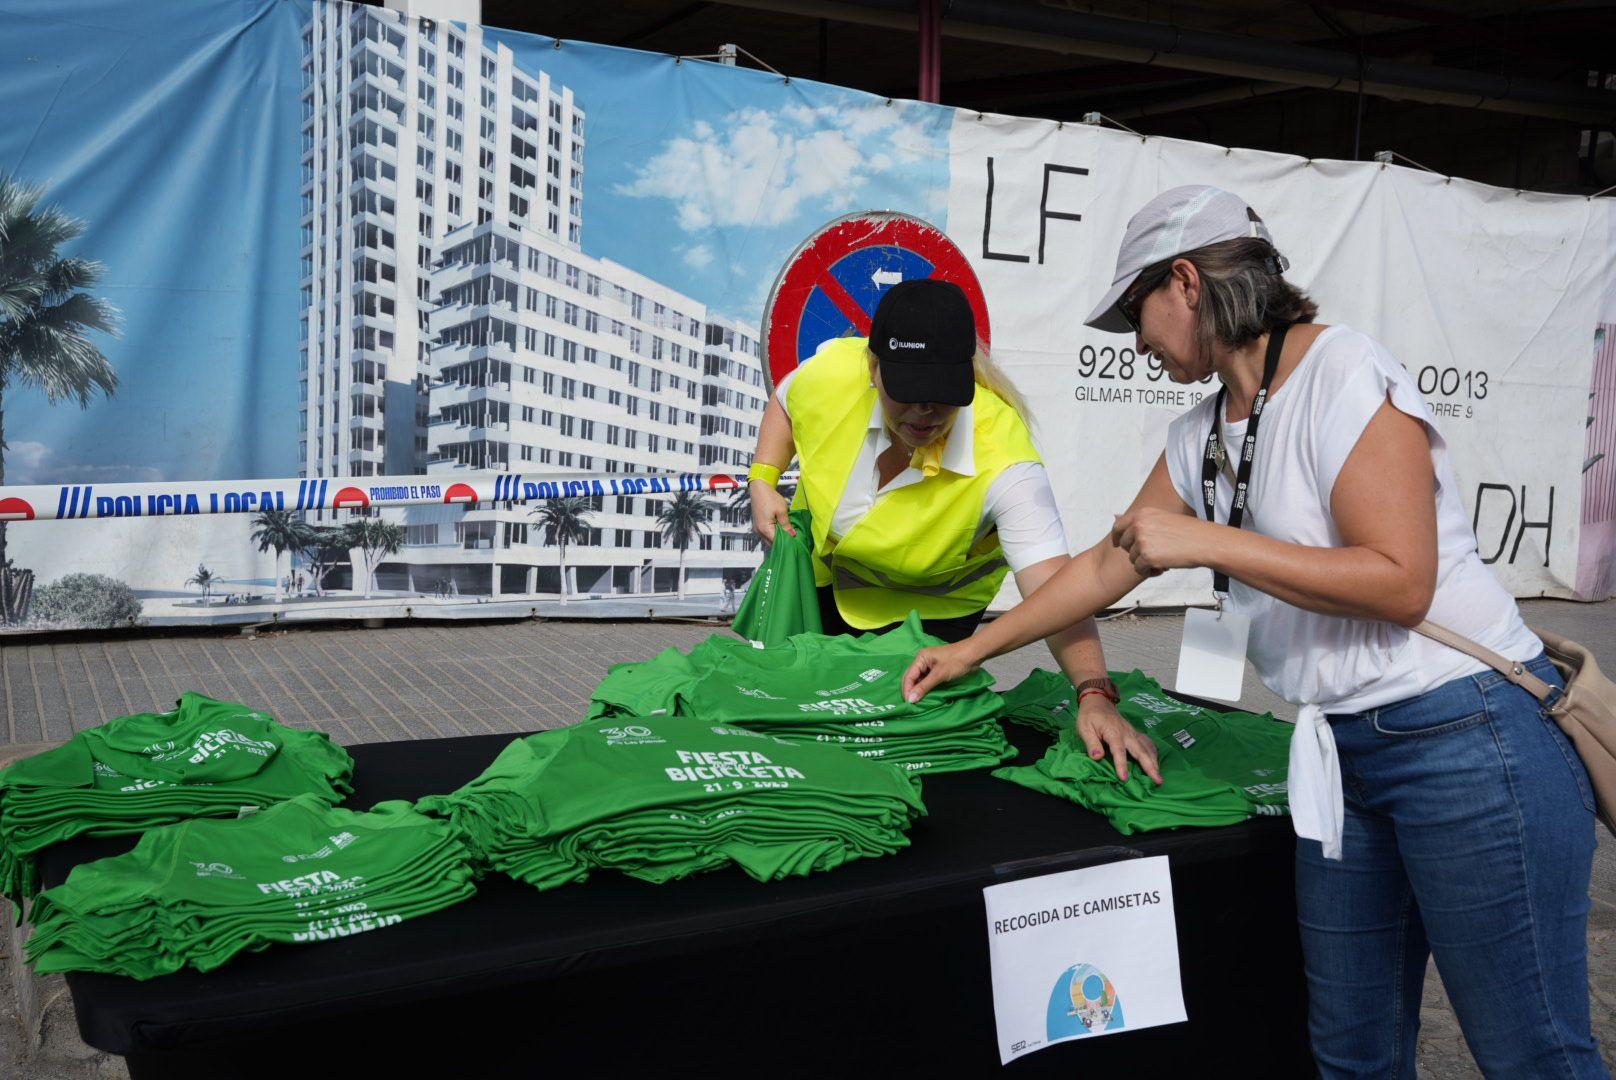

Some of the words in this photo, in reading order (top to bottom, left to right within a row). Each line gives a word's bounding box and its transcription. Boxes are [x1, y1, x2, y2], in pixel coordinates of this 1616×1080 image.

[899, 342, 926, 350] ILUNION
[1078, 345, 1136, 380] 928
[1417, 366, 1489, 400] 0013
[1075, 386, 1132, 404] GILMAR
[1136, 389, 1185, 405] TORRE
[370, 486, 409, 500] PROHIBIDO
[410, 485, 419, 499] EL
[420, 485, 441, 499] PASO
[523, 480, 600, 499] POLICIA
[609, 477, 671, 496] LOCAL
[97, 493, 200, 518] POLICIA
[210, 491, 285, 514] LOCAL
[676, 750, 772, 765] FIESTA
[664, 766, 806, 781] BICICLETA
[256, 870, 341, 894] FIESTA
[994, 908, 1060, 935] RECOGIDA
[1063, 904, 1080, 919] DE
[1083, 891, 1161, 916] CAMISETAS
